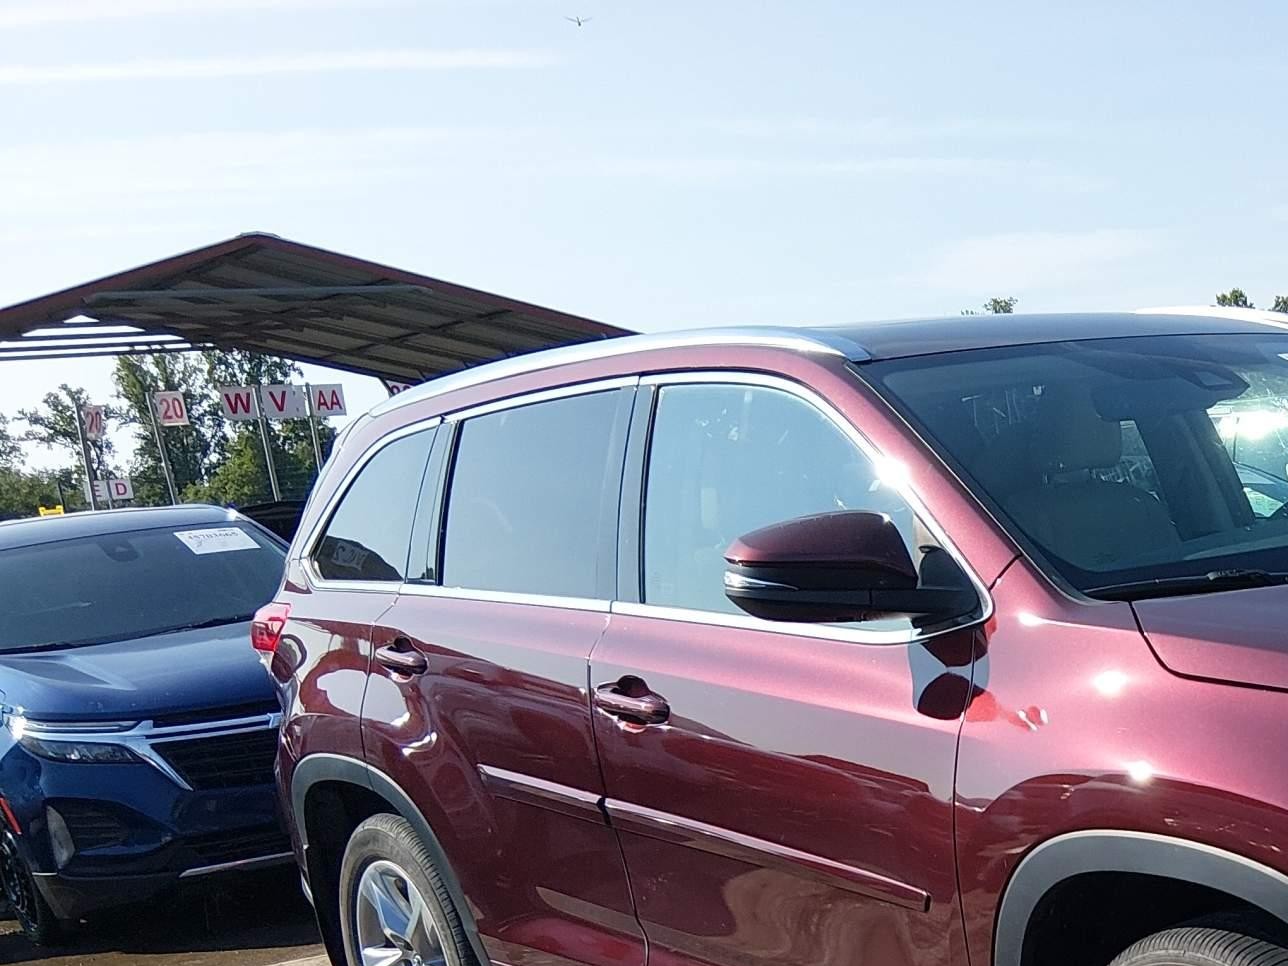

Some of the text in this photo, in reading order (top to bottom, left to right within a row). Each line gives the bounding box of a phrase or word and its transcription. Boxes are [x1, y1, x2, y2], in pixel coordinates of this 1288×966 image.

[160, 398, 184, 420] 20
[224, 392, 251, 414] W
[269, 390, 287, 412] V
[317, 390, 343, 411] AA
[86, 411, 102, 433] 20
[115, 483, 128, 496] D
